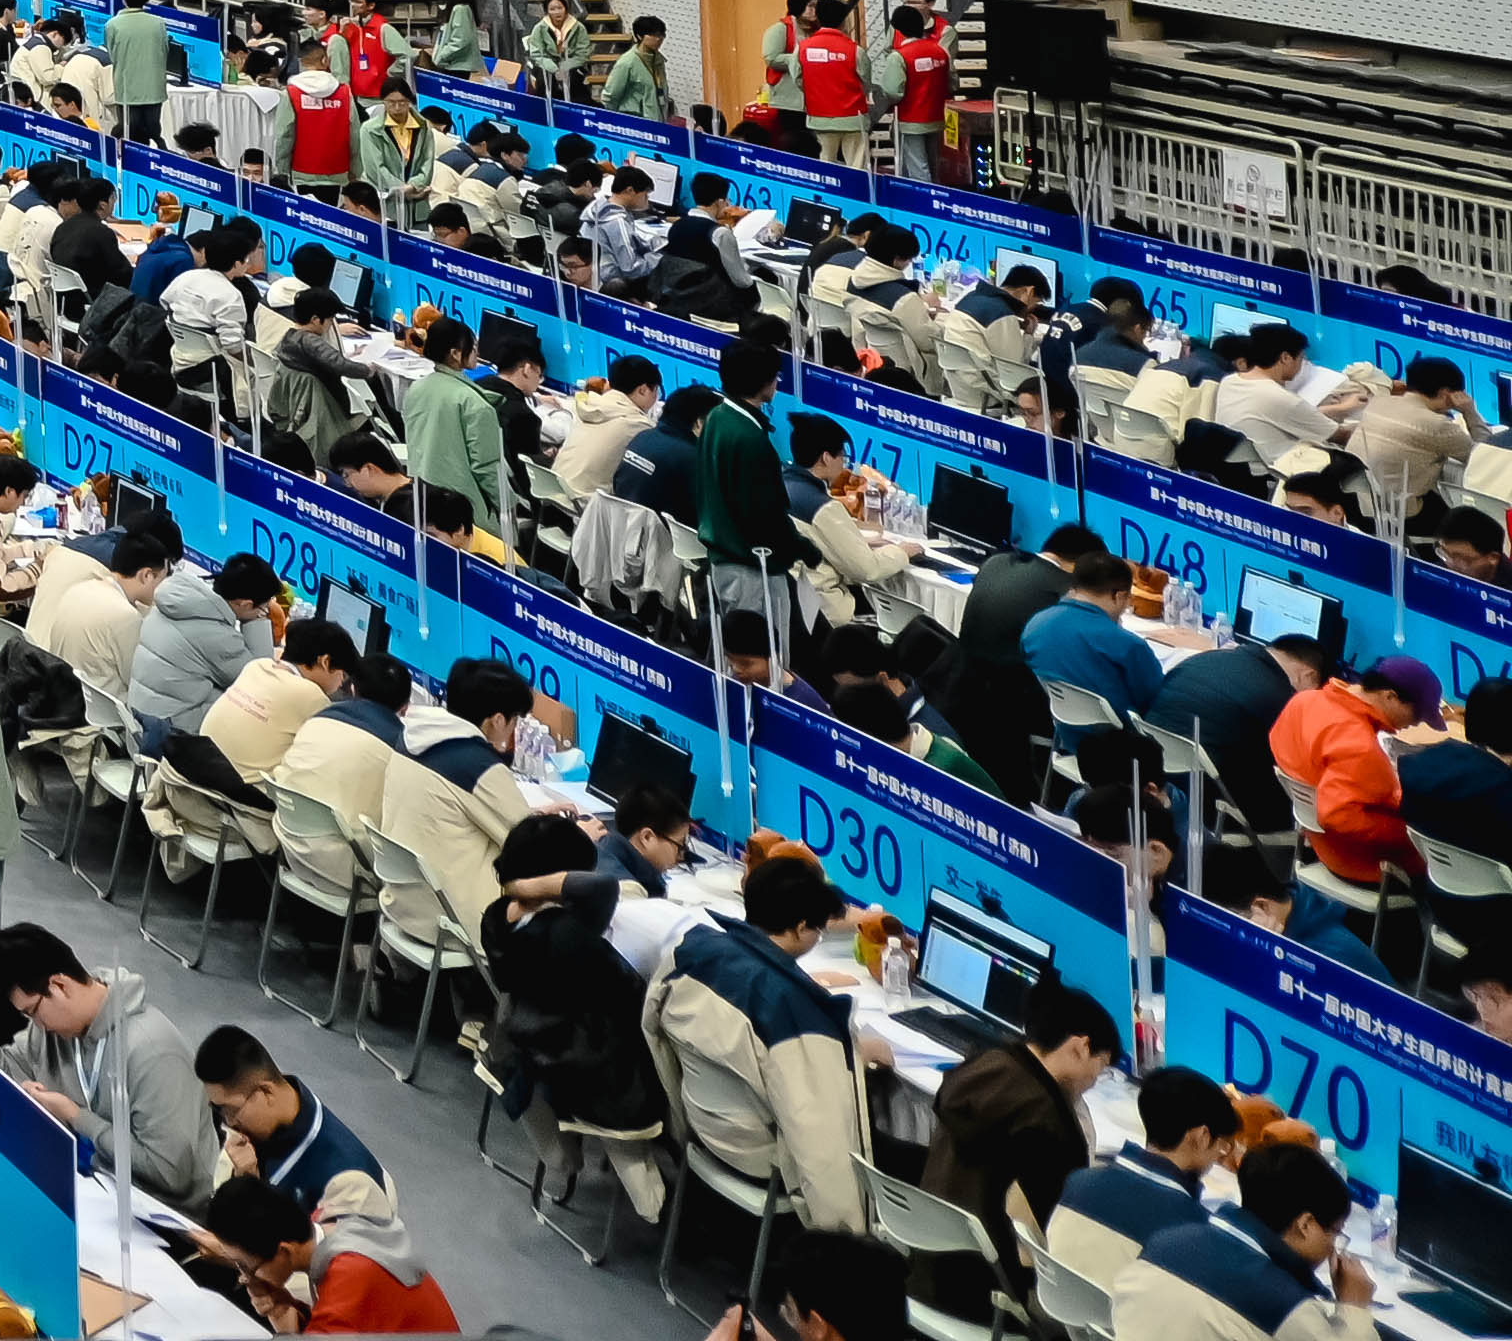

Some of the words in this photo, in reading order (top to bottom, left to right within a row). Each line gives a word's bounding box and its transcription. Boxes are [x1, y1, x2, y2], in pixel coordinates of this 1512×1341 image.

[910, 221, 970, 263] D64
[63, 421, 113, 477] D27
[253, 519, 320, 596] D28
[1119, 515, 1208, 597] D48
[798, 783, 903, 897] D30
[1223, 1007, 1371, 1152] D70
